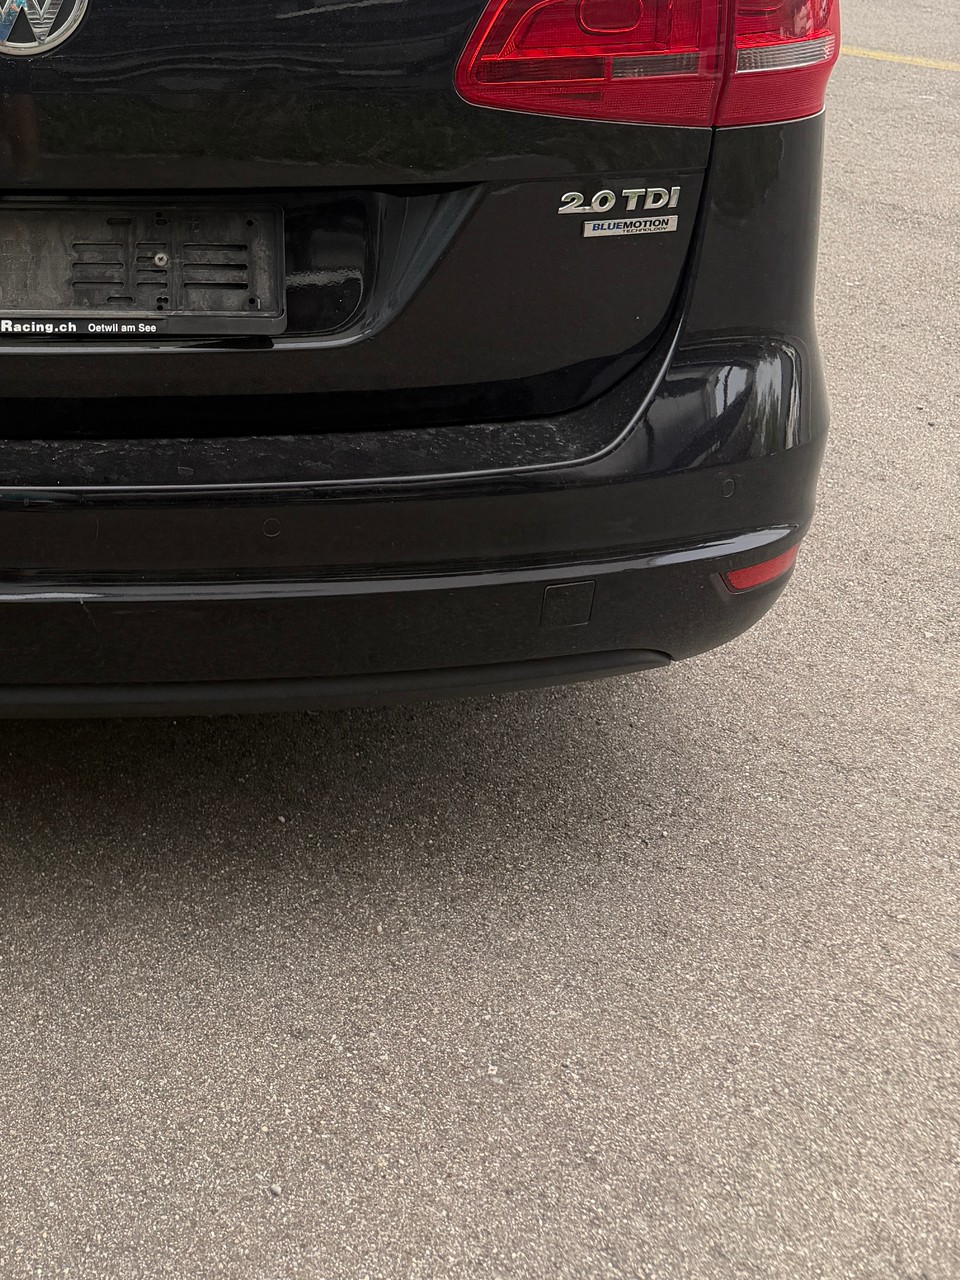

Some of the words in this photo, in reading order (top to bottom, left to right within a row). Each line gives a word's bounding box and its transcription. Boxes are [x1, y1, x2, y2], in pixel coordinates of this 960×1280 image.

[557, 189, 616, 214] 2.0
[621, 186, 681, 211] TDI
[591, 218, 670, 232] BLUEMOTION
[87, 323, 119, 333] Oetwil
[120, 324, 136, 333] am
[138, 323, 157, 333] See
